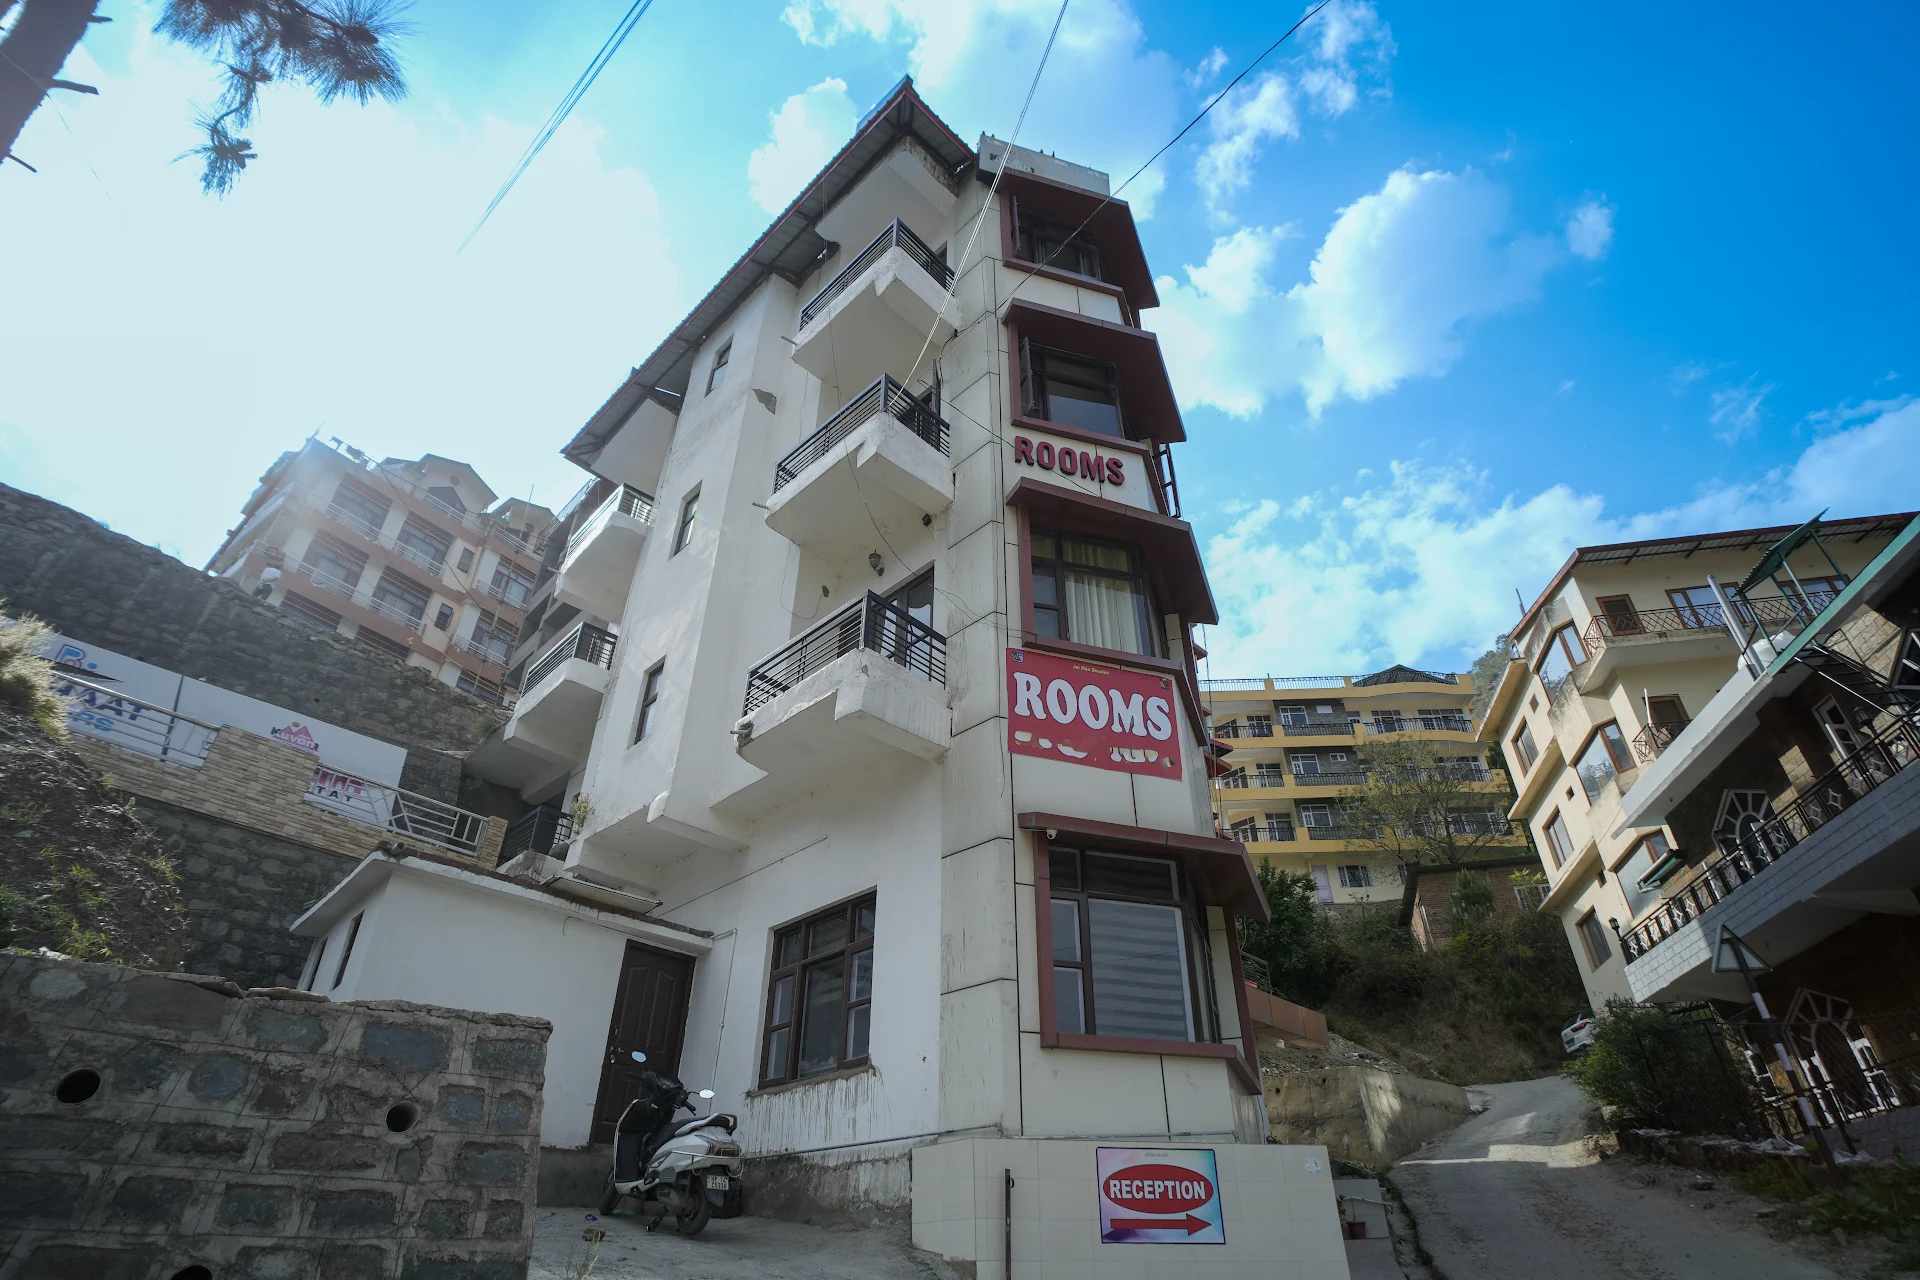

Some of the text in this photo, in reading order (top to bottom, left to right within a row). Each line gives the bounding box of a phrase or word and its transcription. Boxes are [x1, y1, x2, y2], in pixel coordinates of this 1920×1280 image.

[1014, 435, 1125, 486] ROOMS
[1013, 672, 1172, 741] ROOMS
[1109, 1179, 1206, 1200] RECEPTION
